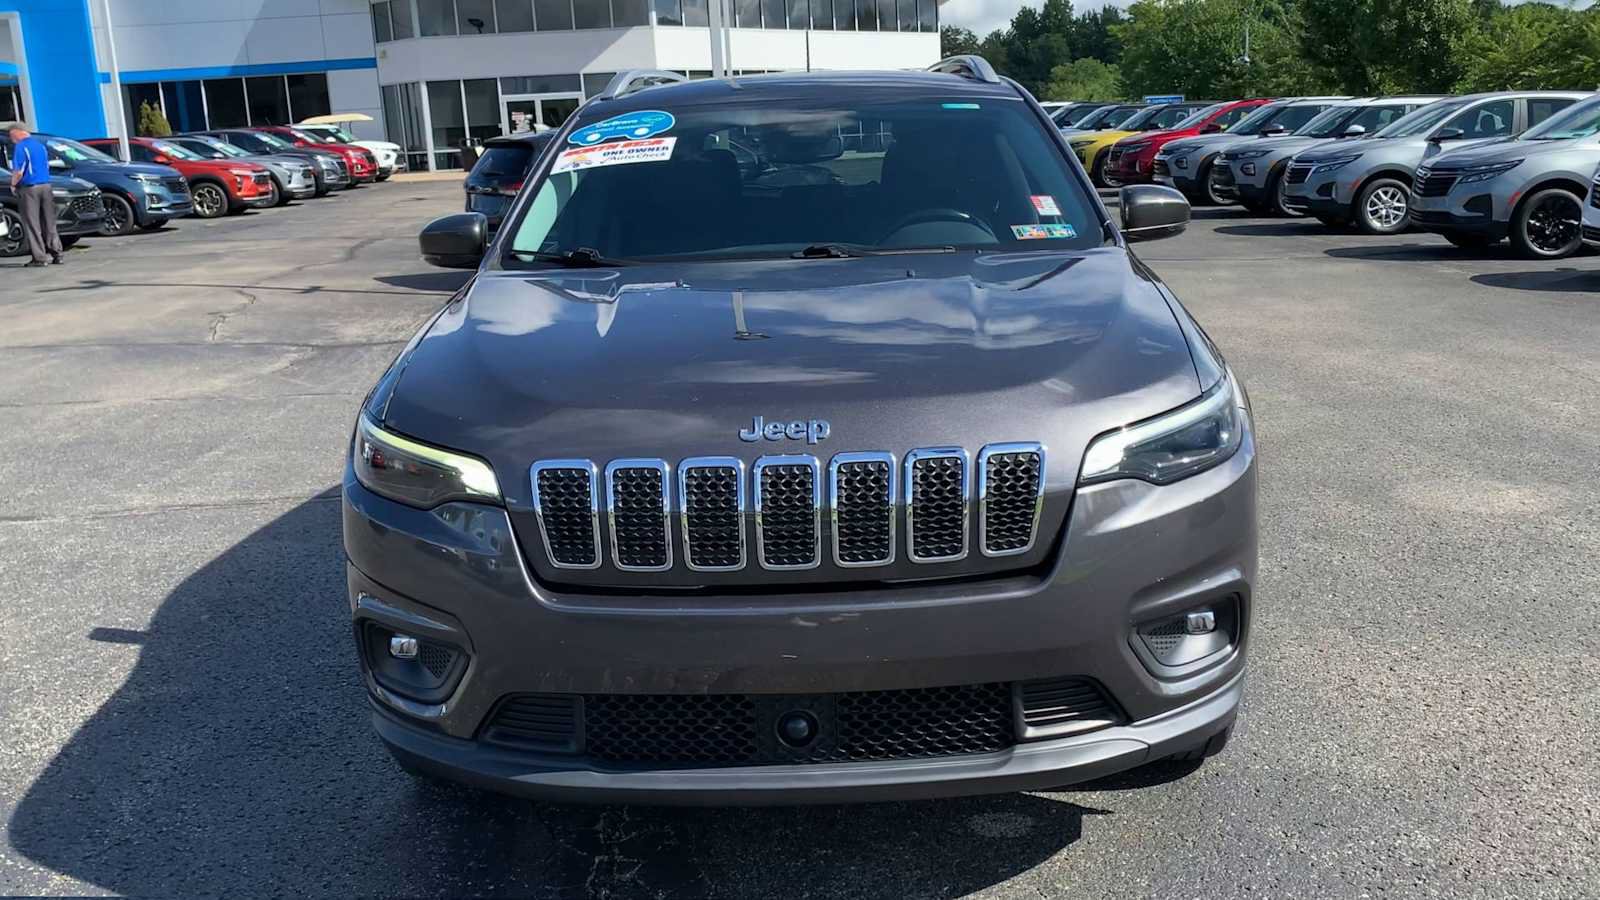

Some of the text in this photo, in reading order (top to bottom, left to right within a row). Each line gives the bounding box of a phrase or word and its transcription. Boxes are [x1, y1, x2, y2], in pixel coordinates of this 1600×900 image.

[603, 146, 669, 157] ONE OWNER
[738, 415, 831, 445] Jeep
